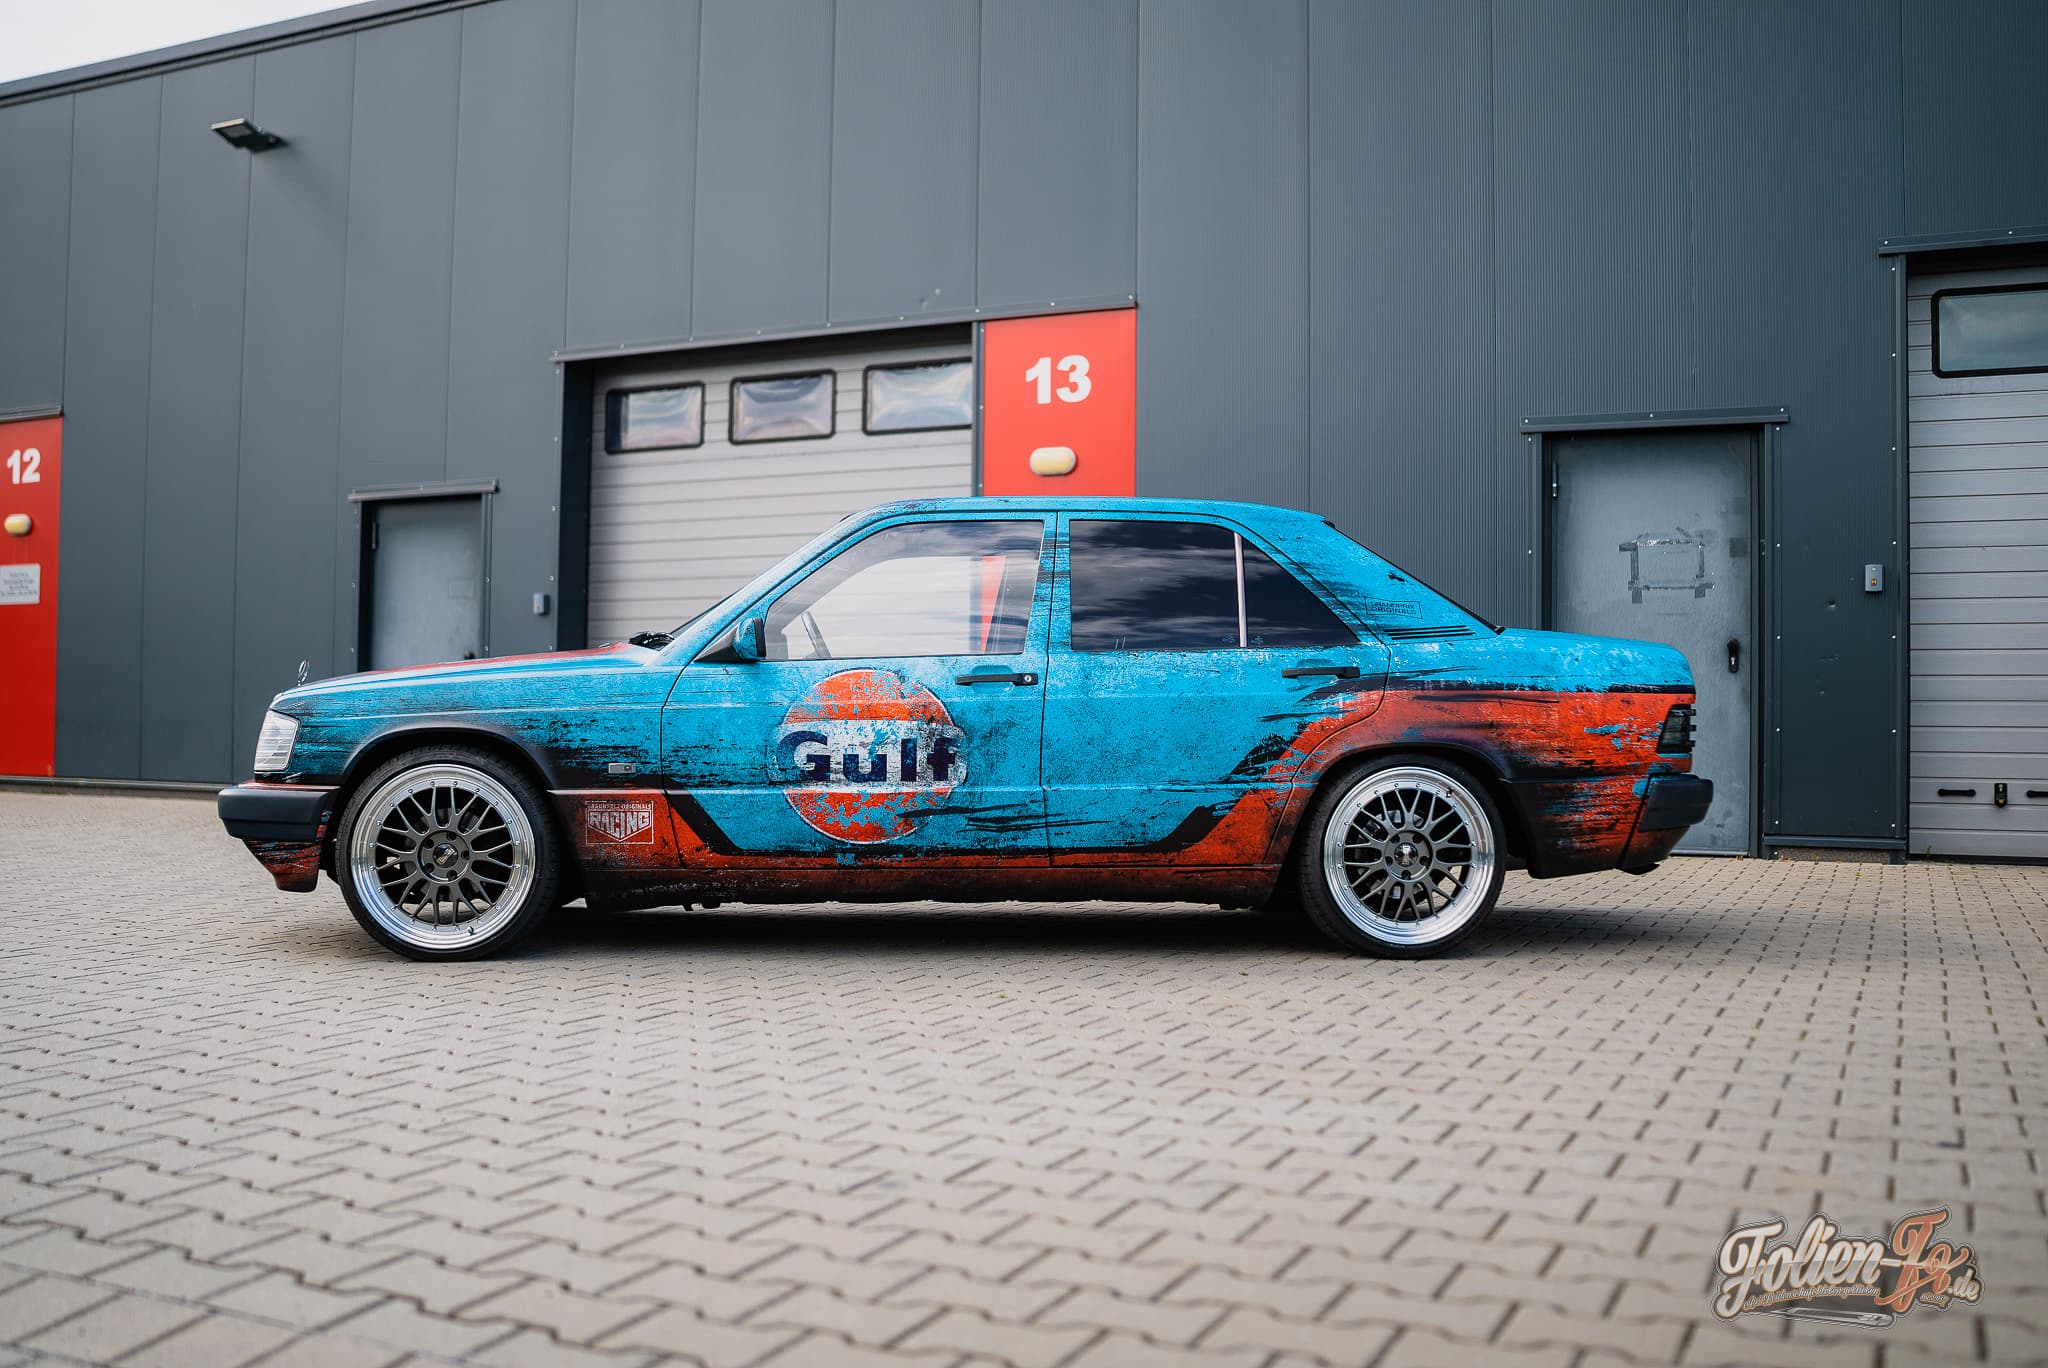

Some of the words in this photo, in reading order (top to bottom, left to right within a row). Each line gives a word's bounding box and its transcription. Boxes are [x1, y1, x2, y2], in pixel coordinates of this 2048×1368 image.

[1025, 355, 1092, 404] 13
[6, 448, 41, 484] 12
[776, 730, 957, 783] Gulf
[589, 812, 650, 838] RACING
